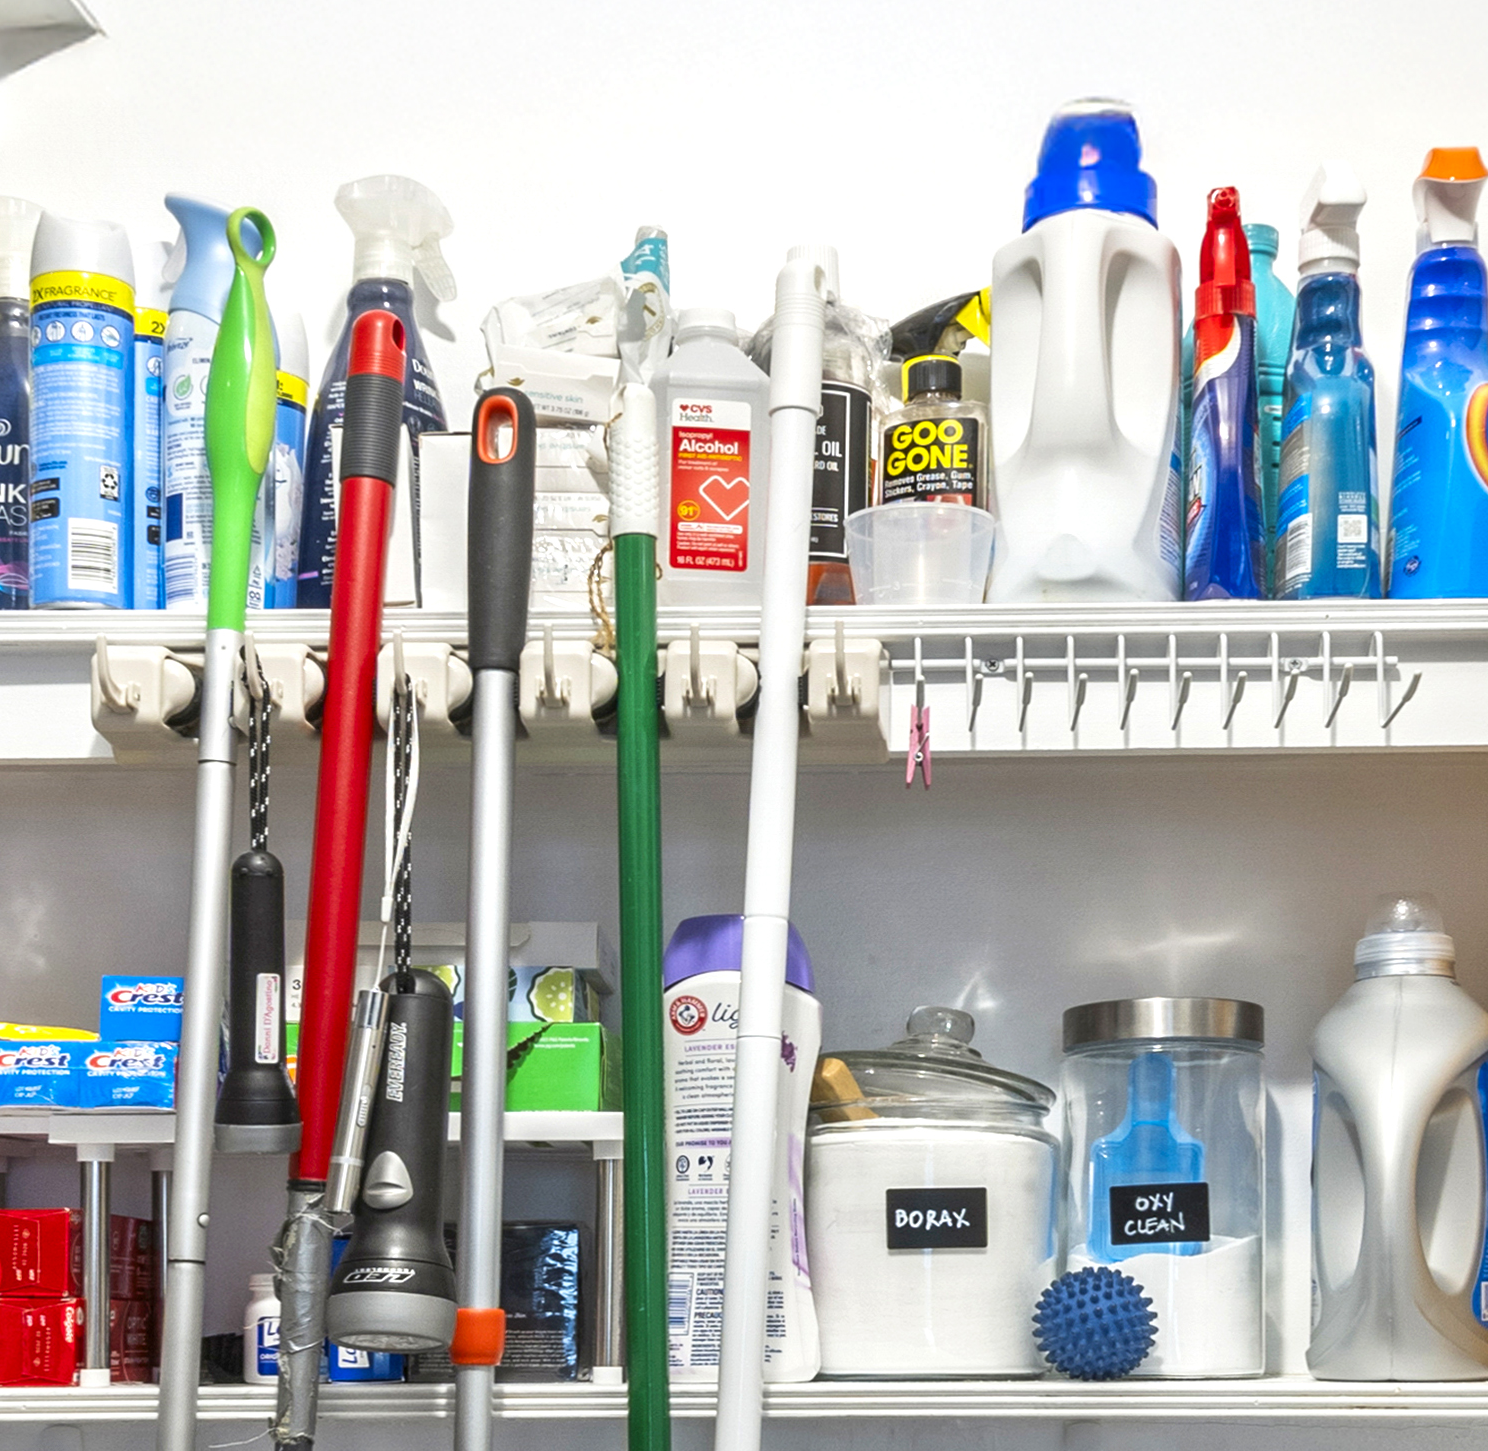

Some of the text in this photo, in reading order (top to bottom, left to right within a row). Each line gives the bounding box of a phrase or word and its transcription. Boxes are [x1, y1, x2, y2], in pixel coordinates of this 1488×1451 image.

[44, 286, 117, 302] FRAGRANCE
[565, 395, 584, 404] skin
[690, 404, 713, 414] CVS
[678, 431, 714, 440] Isopropyl
[892, 419, 964, 450] GOO
[679, 439, 739, 455] Alcohol
[822, 441, 843, 458] OIL
[826, 461, 839, 472] OIL
[887, 444, 969, 477] GONE
[884, 470, 974, 489] Removes Grease, Gum,
[884, 480, 974, 499] Stickers, Crayon, Tape
[136, 982, 177, 994] KID'S
[109, 989, 185, 1005] Crest
[108, 1005, 136, 1013] CAVITY
[680, 996, 706, 1020] HAMMER
[18, 1045, 61, 1056] KID'S
[113, 1046, 155, 1058] KID'S
[684, 1044, 722, 1053] LAVENDER
[88, 1054, 166, 1069] Crest
[386, 1022, 407, 1102] EVEREADY
[695, 1066, 717, 1074] comfort
[689, 1075, 700, 1083] that
[705, 1083, 733, 1091] fragrance
[688, 1187, 724, 1196] LAVENDER
[1135, 1191, 1174, 1213] OXY
[895, 1207, 970, 1231] BORAX
[1124, 1212, 1186, 1236] CLEAN
[344, 1270, 416, 1283] LED
[696, 1288, 724, 1296] CAUTION
[62, 1306, 74, 1343] Colgate
